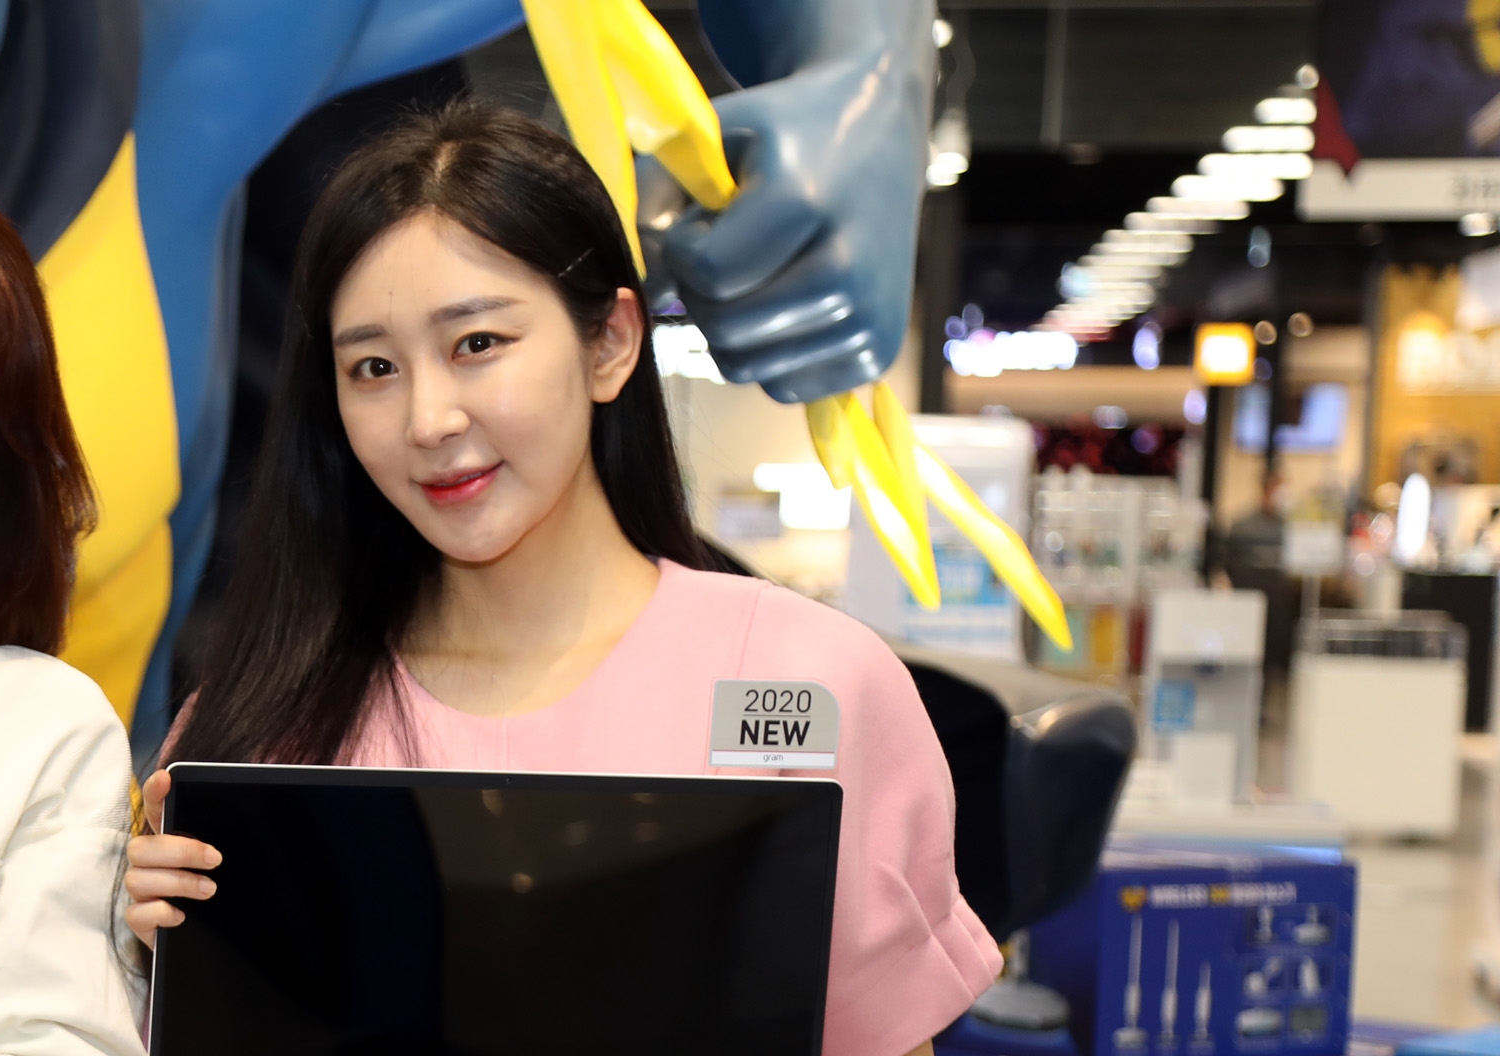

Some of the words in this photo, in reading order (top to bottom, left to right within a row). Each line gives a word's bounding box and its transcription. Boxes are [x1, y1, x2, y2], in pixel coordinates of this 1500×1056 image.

[744, 689, 812, 713] 2020
[739, 719, 810, 746] NEW
[763, 753, 784, 762] gram
